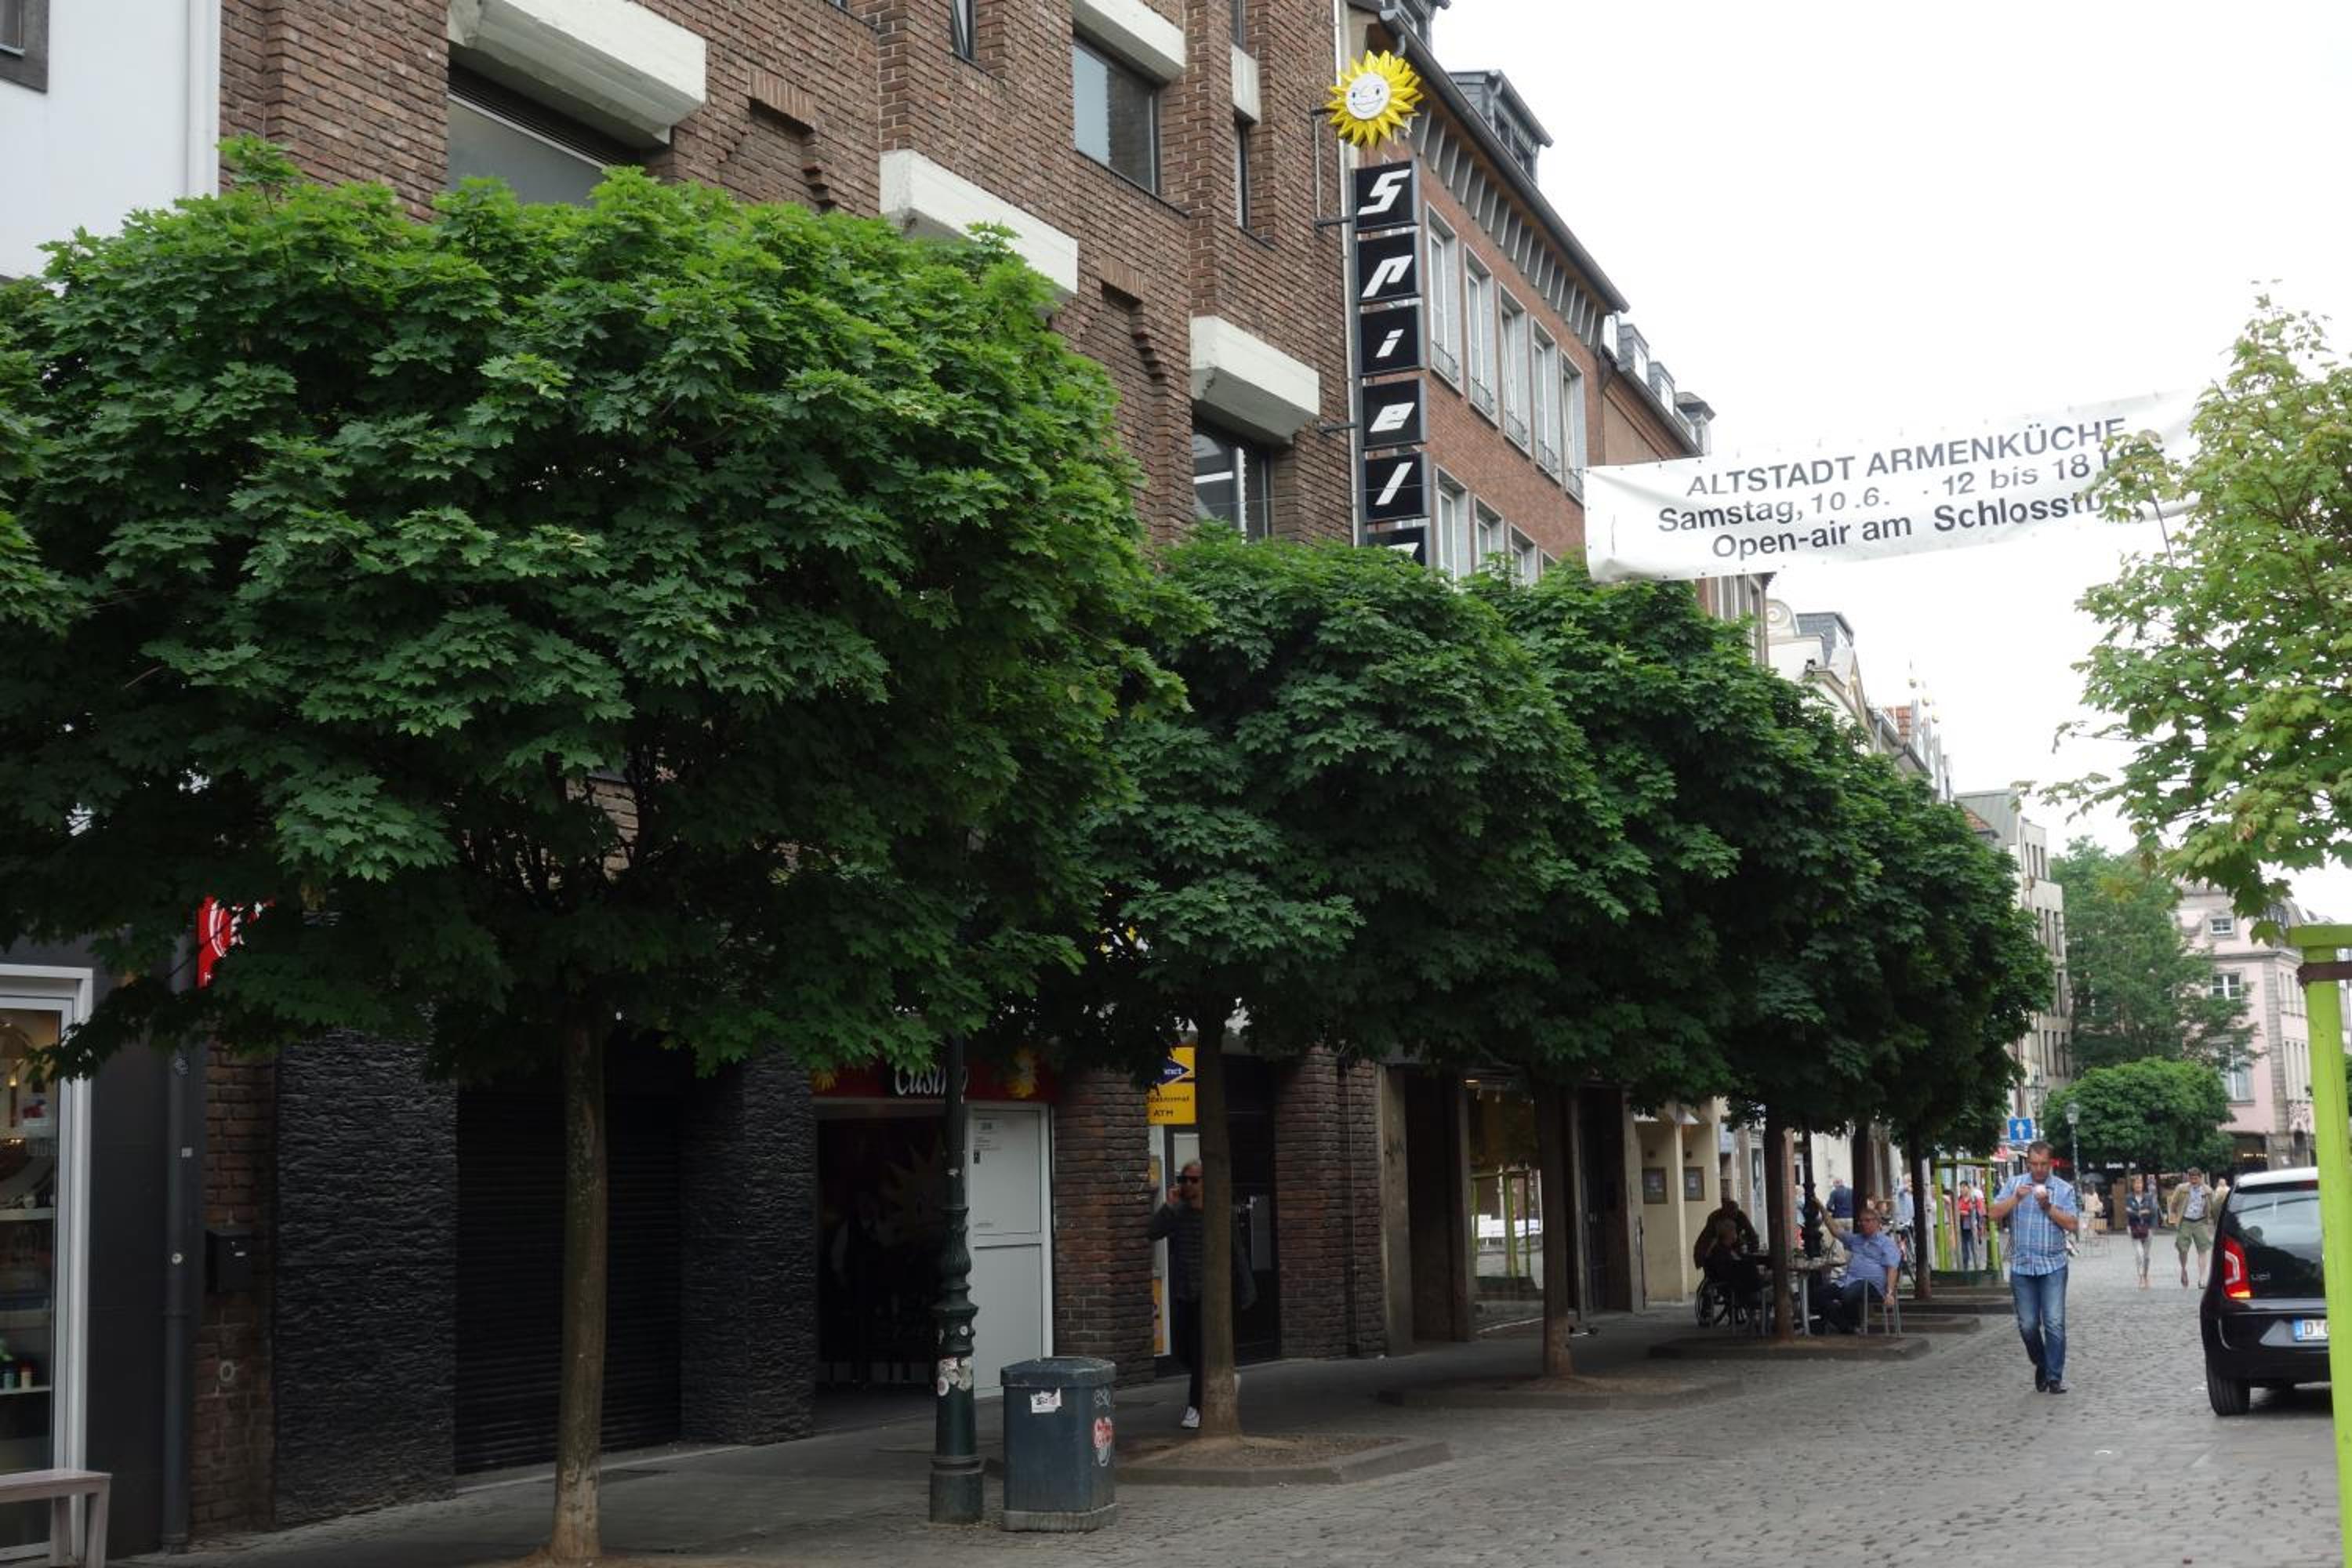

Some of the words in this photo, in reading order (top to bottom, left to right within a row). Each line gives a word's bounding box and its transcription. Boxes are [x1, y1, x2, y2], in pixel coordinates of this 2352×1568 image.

[1658, 500, 1802, 532] Samstag,
[1942, 472, 1976, 495] 12
[1991, 466, 2038, 490] bis
[2053, 454, 2090, 481] 18
[1686, 456, 1855, 496] ALTSTADT
[1866, 418, 2126, 477] ARMENKÜCHE
[1712, 521, 1851, 561] Open-air
[1862, 516, 1911, 541] am
[1934, 492, 2106, 532] Schlosstu
